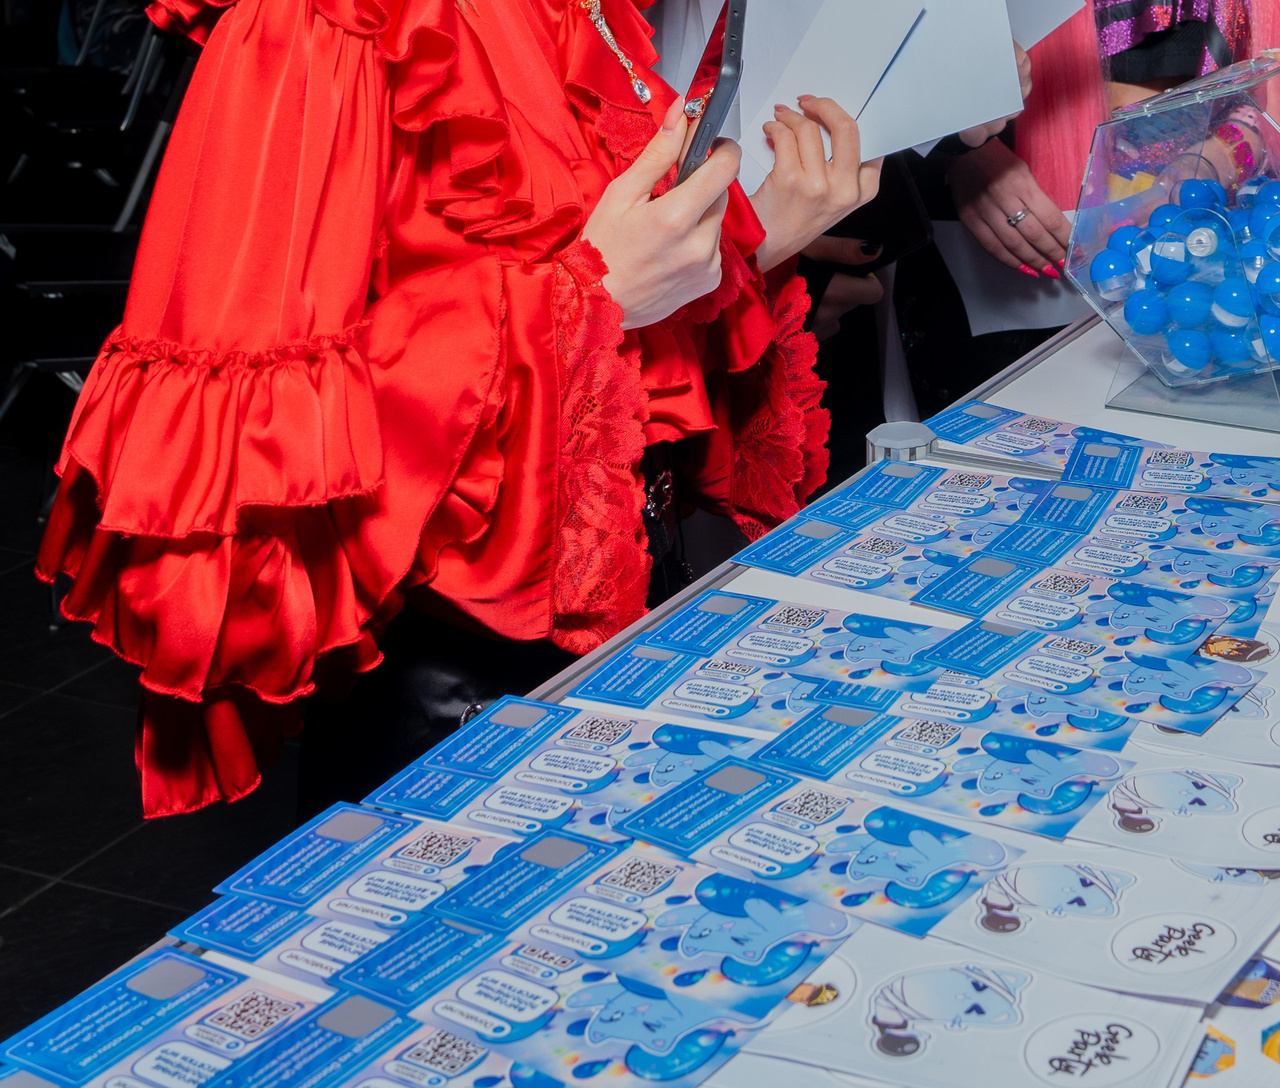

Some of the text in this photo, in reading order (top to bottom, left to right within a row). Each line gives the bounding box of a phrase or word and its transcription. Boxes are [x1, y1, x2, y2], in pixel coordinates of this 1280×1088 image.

[1070, 561, 1113, 571] Donatov.net
[815, 571, 856, 582] Donatov.net
[1001, 612, 1046, 624] Donatov.net
[730, 650, 778, 660] Donatov.net
[1007, 673, 1055, 686] Donatov.net
[666, 701, 716, 712] Donatov.net
[906, 705, 956, 716] Donatov.net
[520, 773, 573, 786] Donatov.net
[851, 772, 903, 788] Donatov.net
[472, 812, 527, 827] Donatov.net
[714, 848, 768, 868] Donatov.net
[333, 901, 392, 918] Donatov.net
[533, 927, 592, 948] Donatov.net
[1127, 925, 1185, 965] Party
[1173, 922, 1215, 958] Geek
[437, 1003, 496, 1029] Donatov.net
[437, 1003, 496, 1029] Donatov.net
[1092, 1023, 1133, 1066] Geek
[1046, 1029, 1102, 1077] Party
